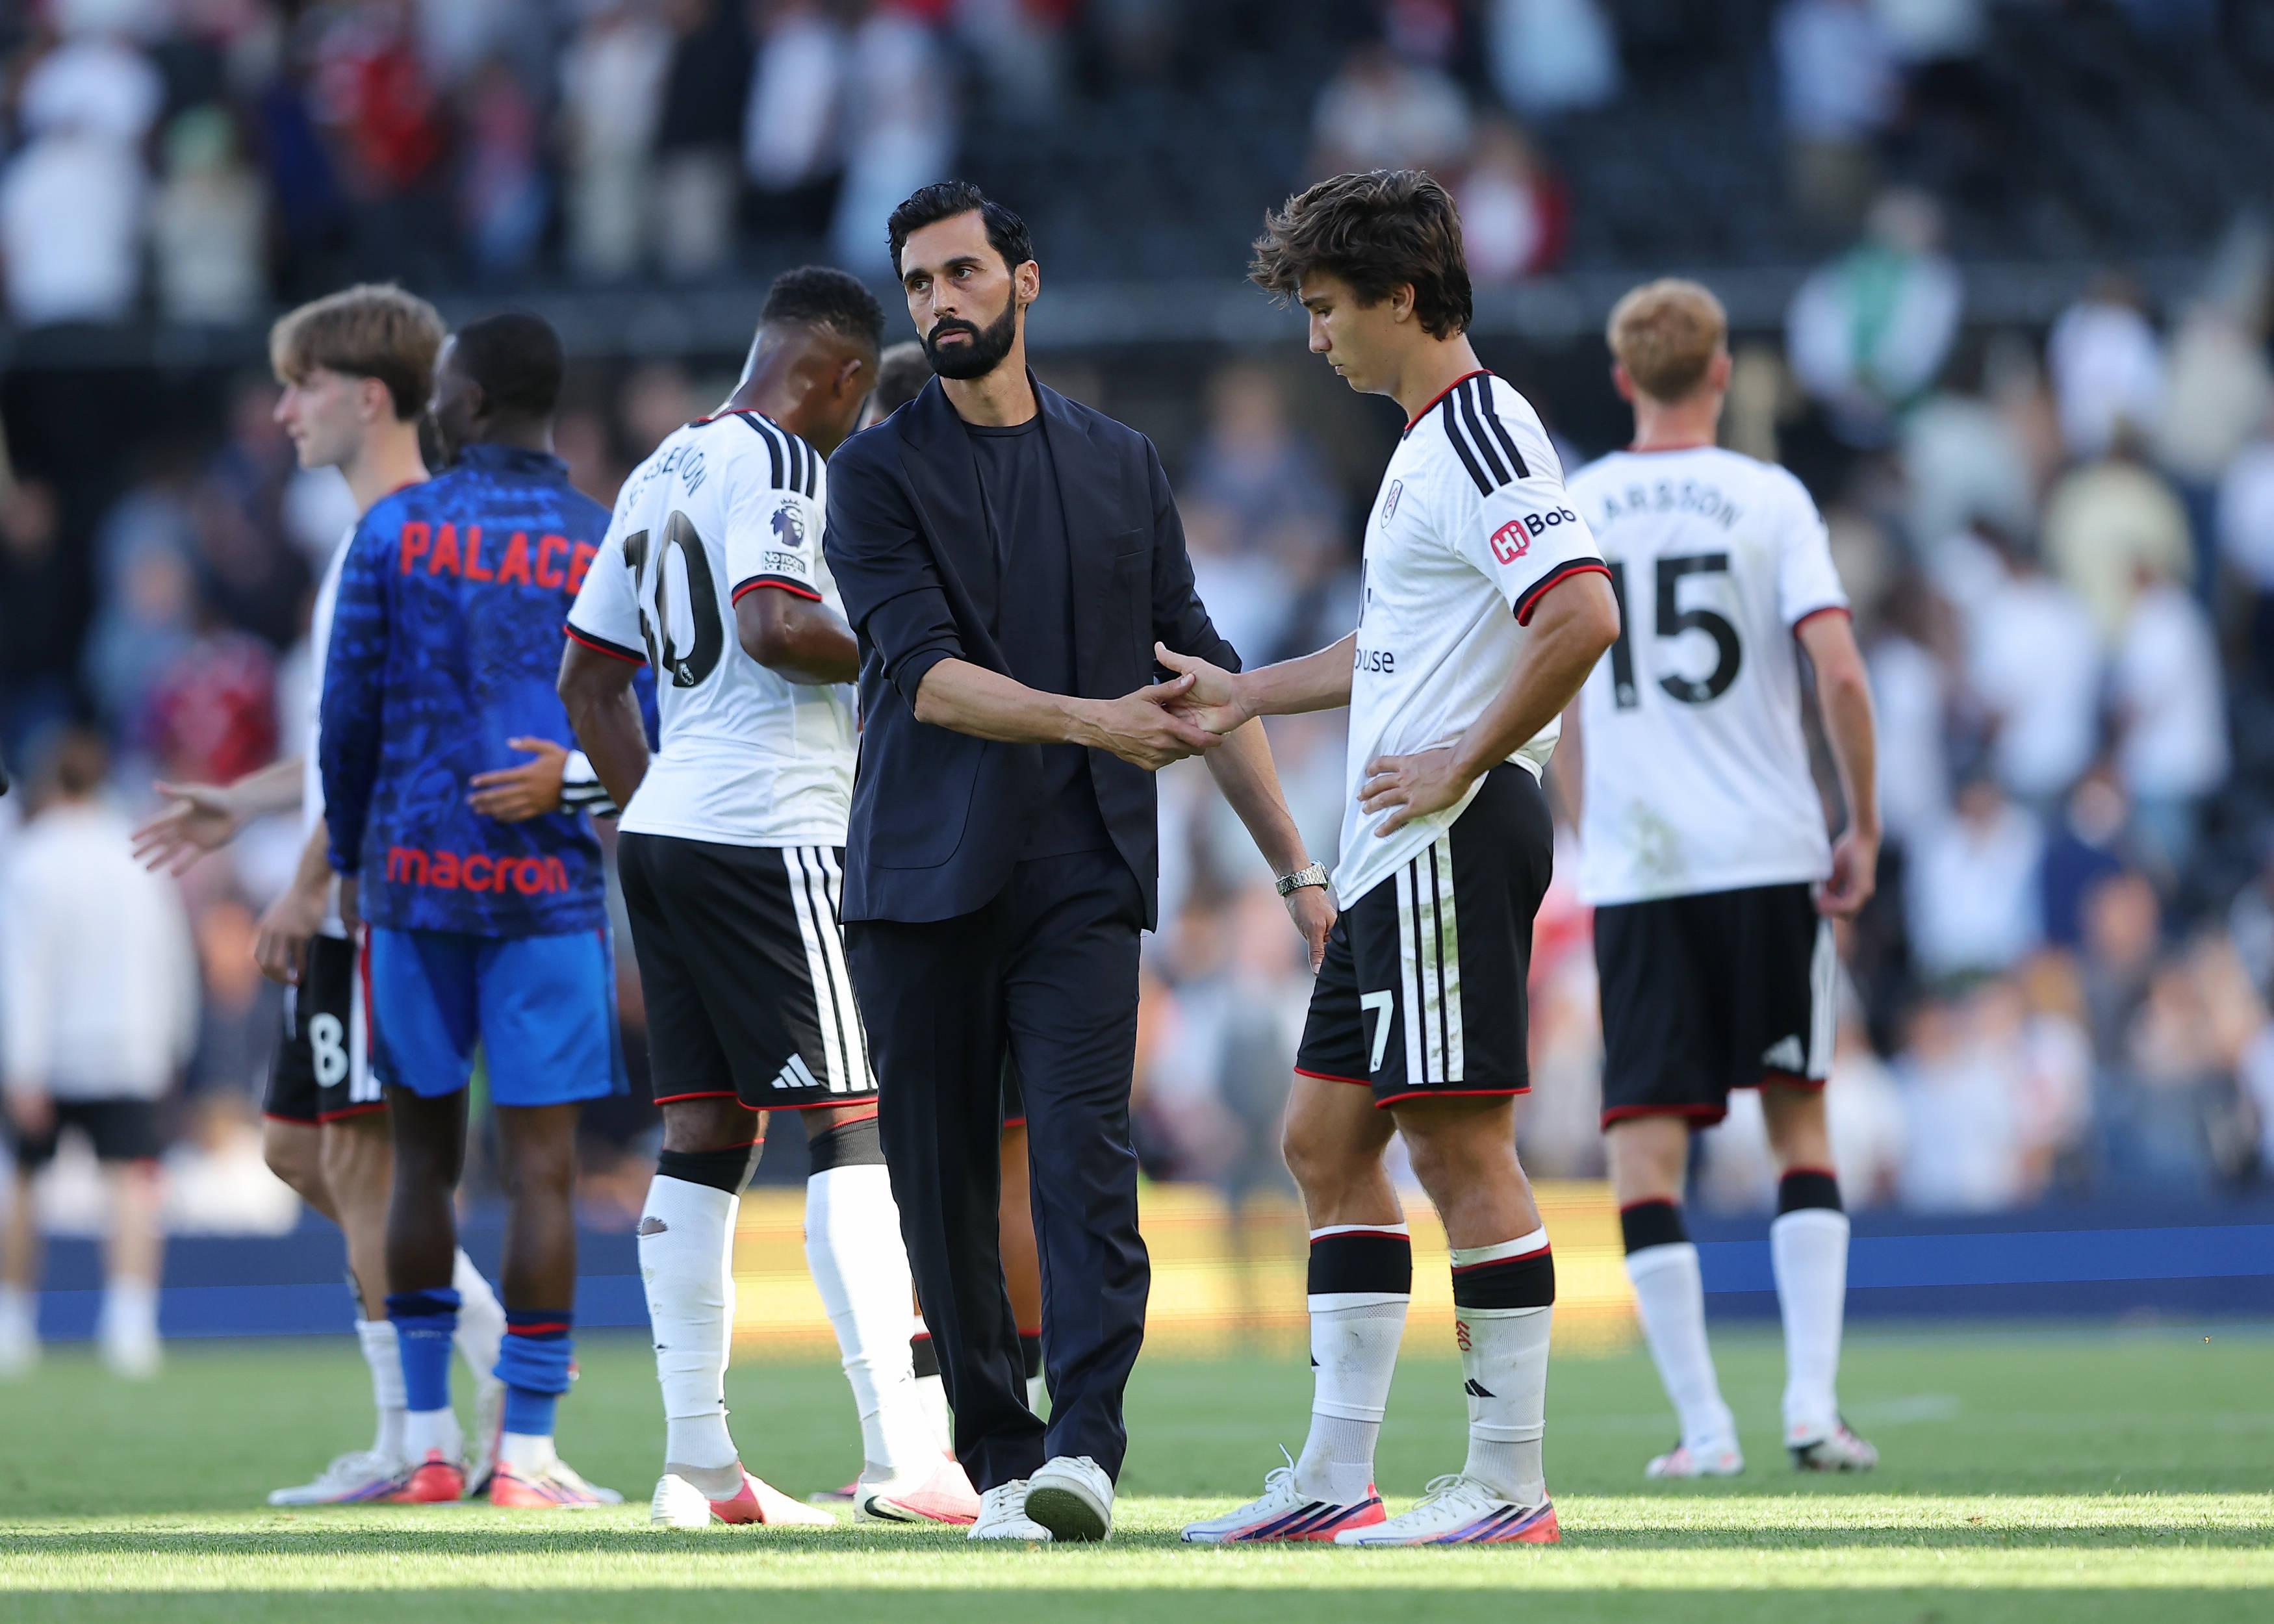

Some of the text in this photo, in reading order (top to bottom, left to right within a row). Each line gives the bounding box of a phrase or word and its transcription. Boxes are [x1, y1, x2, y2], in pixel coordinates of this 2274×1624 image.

[1596, 482, 1743, 530] ARSSON
[400, 520, 598, 596] PALACE
[1607, 553, 1741, 709] 15
[387, 846, 568, 894] macron
[309, 1011, 349, 1088] 8
